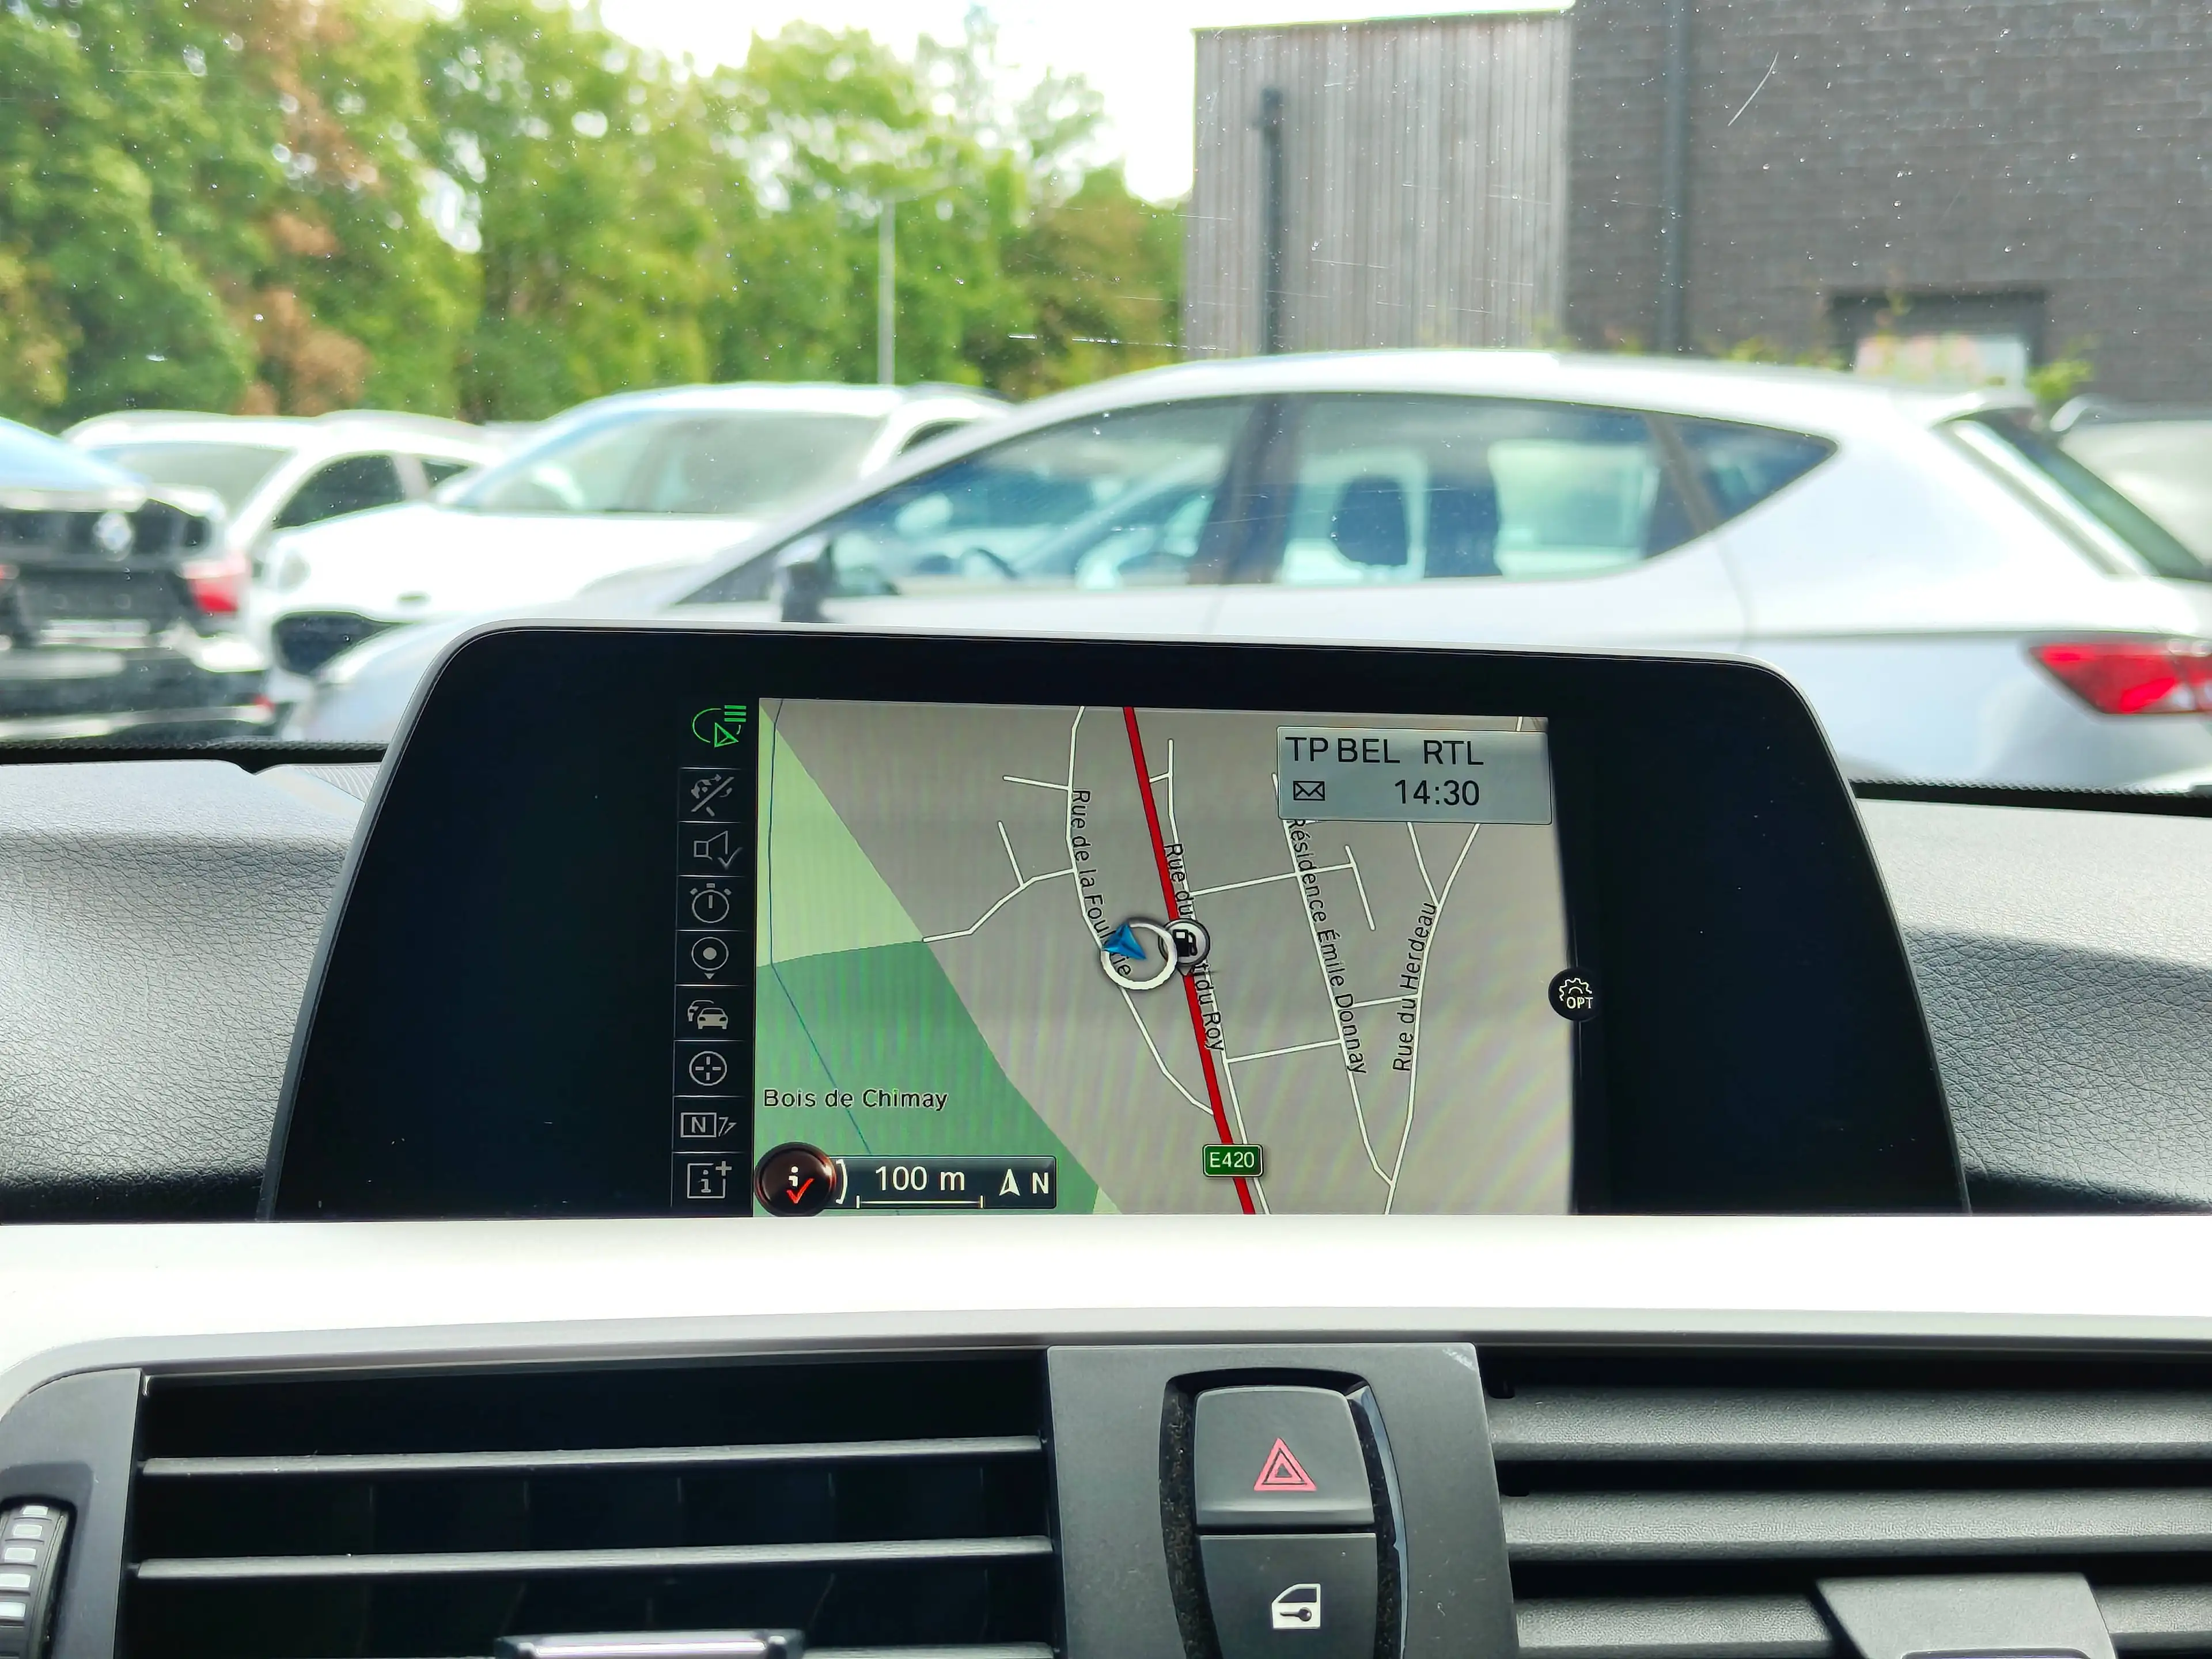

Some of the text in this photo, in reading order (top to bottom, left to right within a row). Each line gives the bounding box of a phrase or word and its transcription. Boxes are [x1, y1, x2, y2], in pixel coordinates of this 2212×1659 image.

[1285, 736, 1484, 766] TP BEL RTL
[1395, 779, 1480, 806] 14:30
[1164, 843, 1185, 882] Rue
[1071, 790, 1132, 975] Rue de la Foulie
[1175, 891, 1195, 915] du
[1195, 979, 1214, 1005] du
[1392, 902, 1437, 1071] Rue du Herdeau
[1317, 929, 1346, 987] Émile
[1335, 994, 1367, 1074] Donnay
[1566, 997, 1594, 1009] OPT
[1202, 1012, 1224, 1051] Roy
[764, 1089, 948, 1111] Bois de Chimay
[1210, 1152, 1255, 1168] E420
[875, 1166, 1050, 1194] 100 m N
